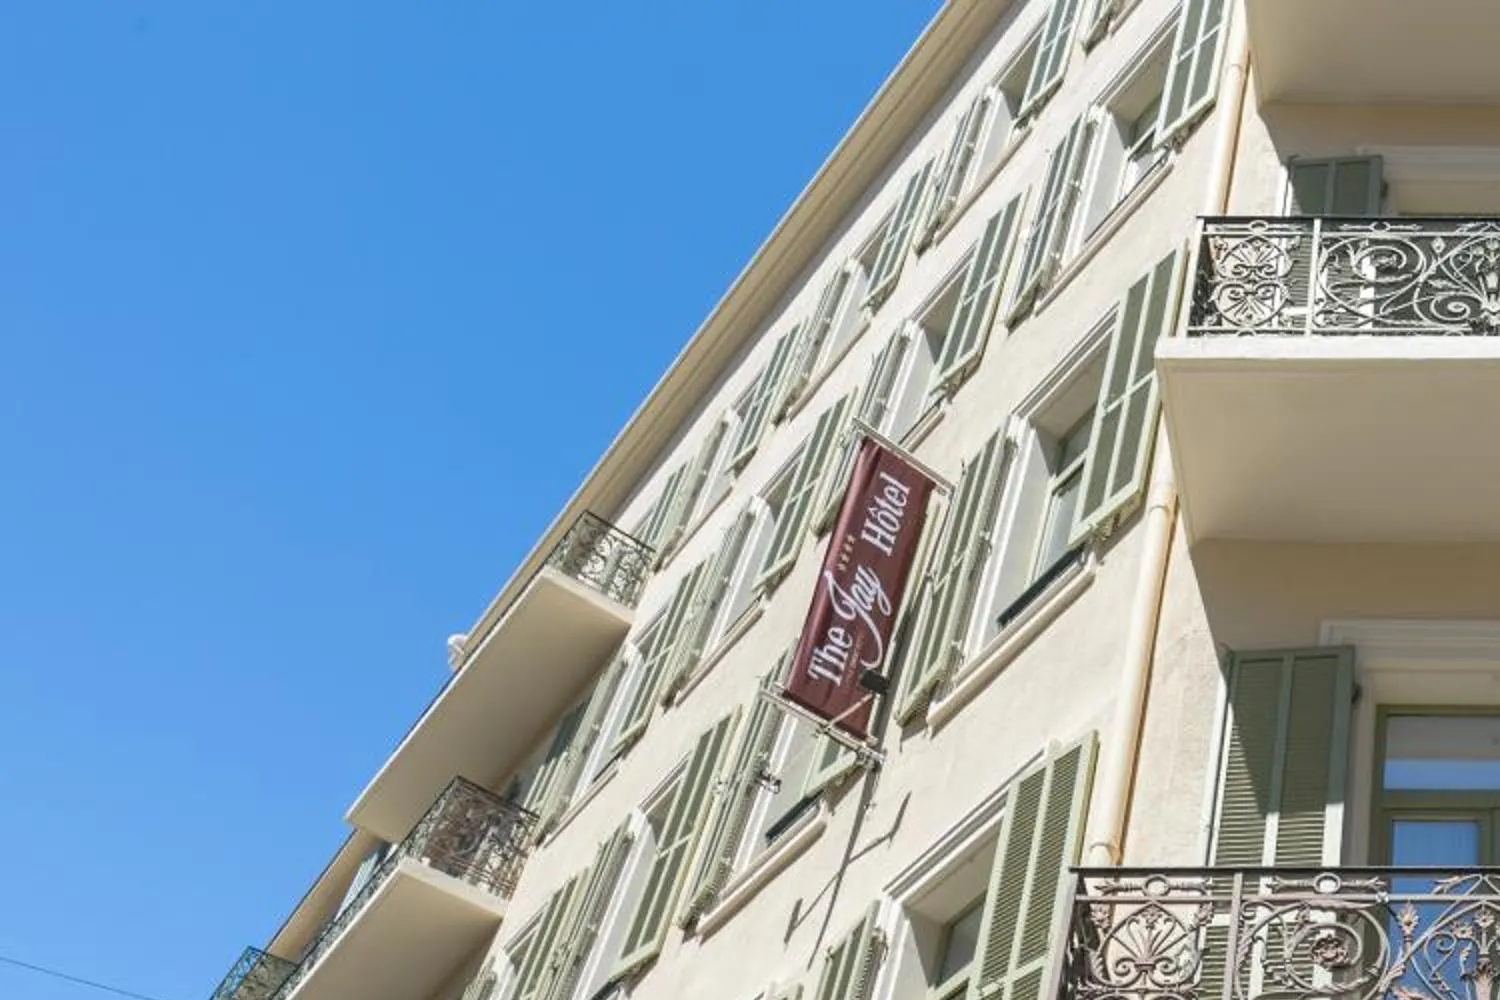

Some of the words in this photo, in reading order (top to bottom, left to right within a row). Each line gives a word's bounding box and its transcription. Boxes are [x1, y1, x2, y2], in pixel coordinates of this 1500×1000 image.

[861, 472, 910, 556] Hôtel
[807, 626, 853, 687] The
[824, 564, 892, 669] Jay
